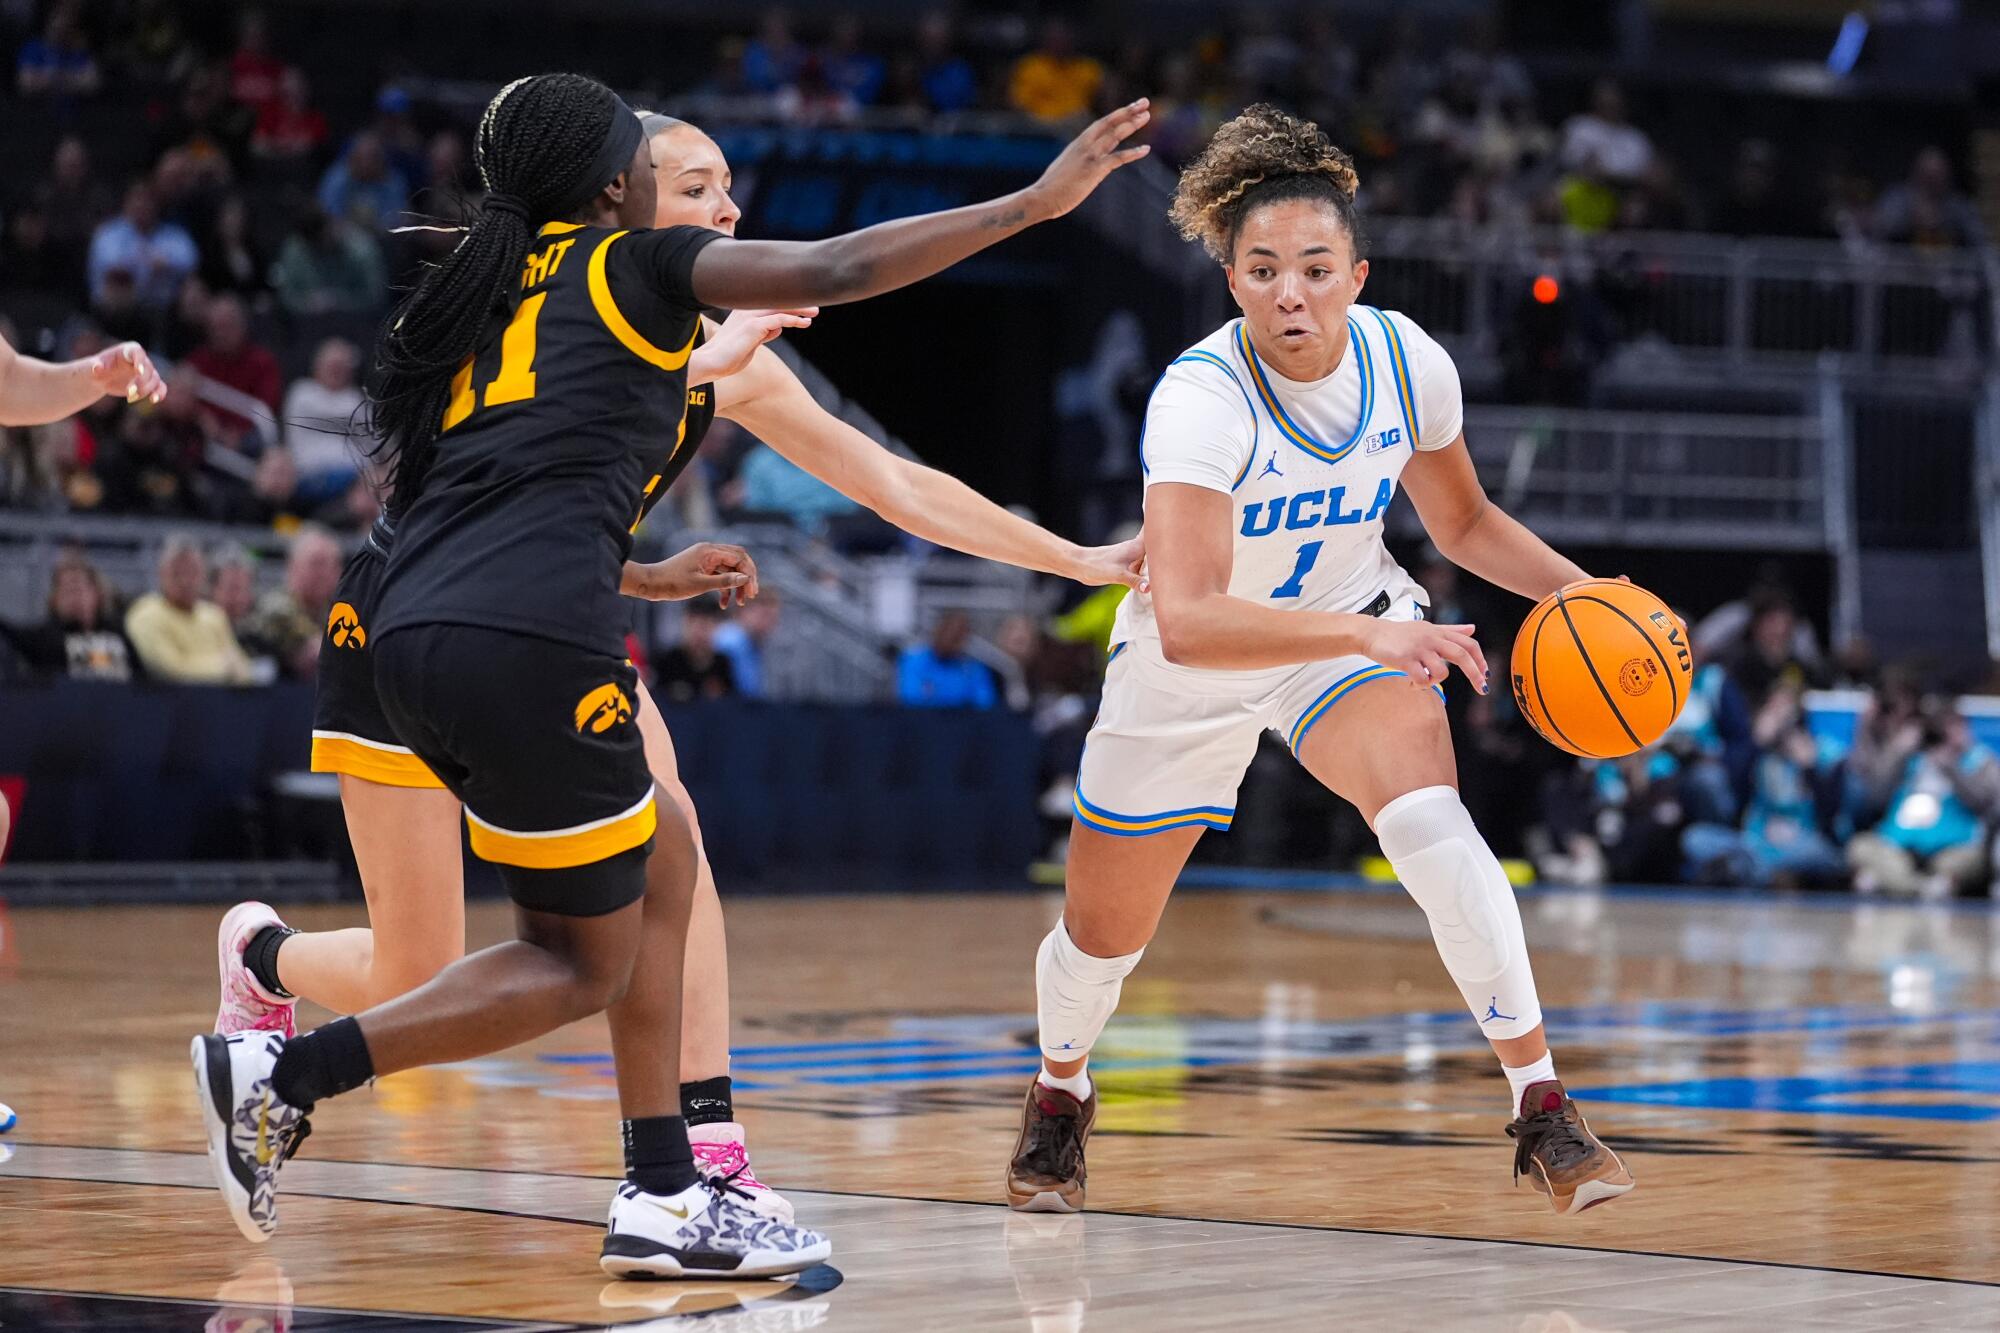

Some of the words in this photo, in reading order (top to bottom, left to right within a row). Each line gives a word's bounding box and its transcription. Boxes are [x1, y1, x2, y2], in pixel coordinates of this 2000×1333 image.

[688, 390, 706, 406] IG
[1240, 478, 1391, 537] UCLA
[1270, 540, 1324, 598] 1
[1649, 611, 1690, 672] EVO
